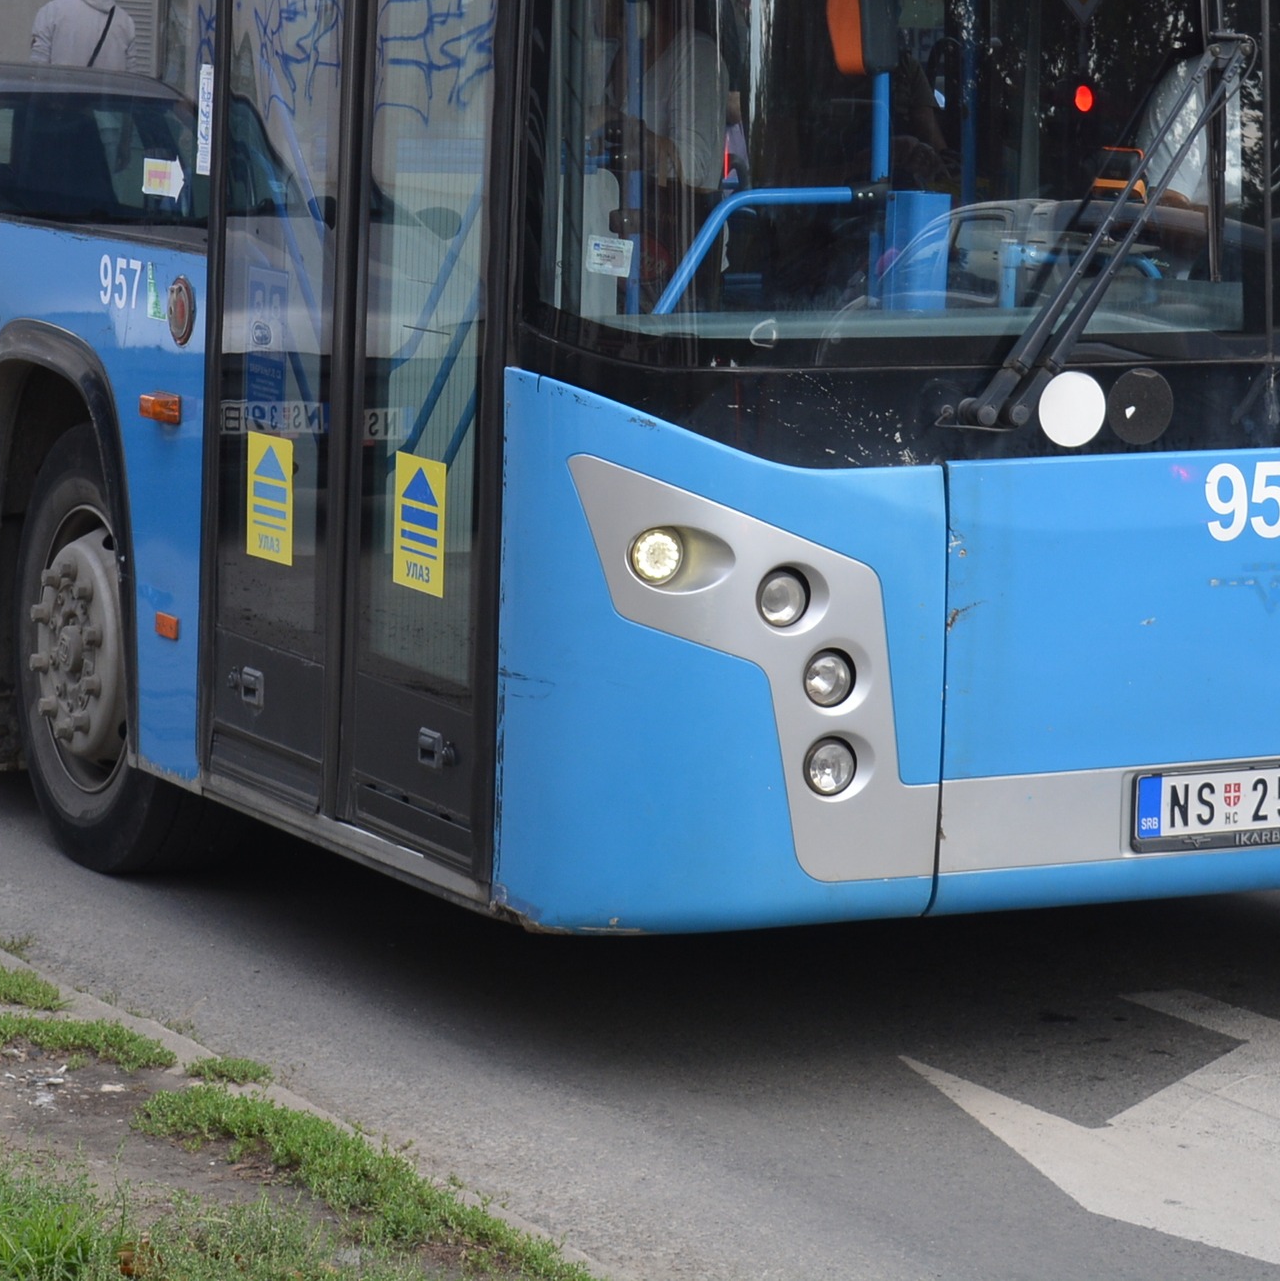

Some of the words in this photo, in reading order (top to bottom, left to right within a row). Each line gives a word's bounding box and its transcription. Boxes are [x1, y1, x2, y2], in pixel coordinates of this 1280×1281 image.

[99, 254, 142, 309] 957
[258, 533, 281, 554] УЛАЗ
[405, 560, 431, 584] УЛАЗ
[1169, 782, 1216, 828] NS
[1140, 817, 1158, 831] SRB
